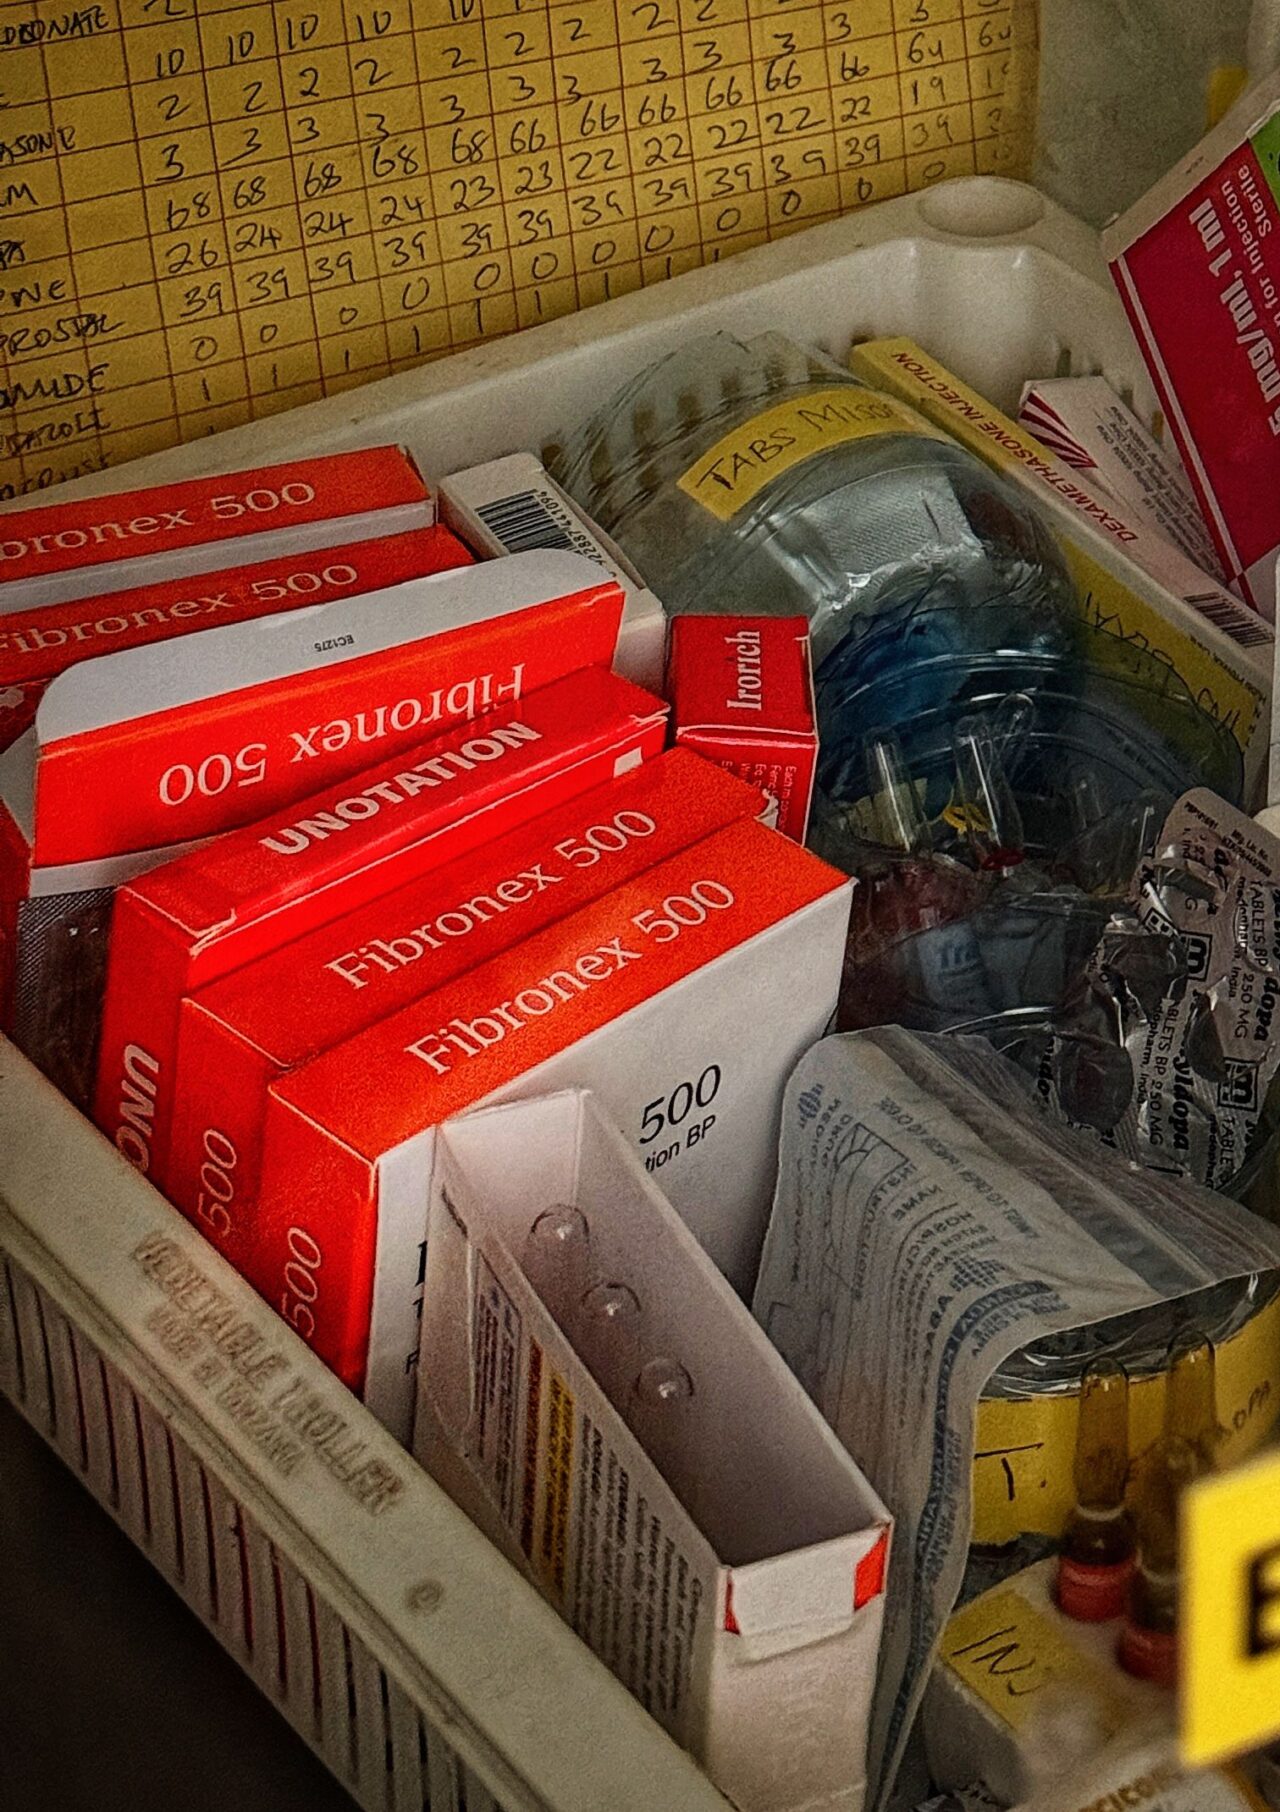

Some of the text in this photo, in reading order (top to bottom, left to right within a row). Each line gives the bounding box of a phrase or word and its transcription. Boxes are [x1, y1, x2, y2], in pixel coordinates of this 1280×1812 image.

[156, 10, 391, 79] 10 10 10 10
[157, 94, 192, 120] 2
[243, 81, 268, 112] 2
[299, 67, 319, 97] 2
[354, 59, 393, 86] 2
[441, 47, 476, 69] 2
[504, 31, 534, 56] 2
[562, 18, 591, 41] 2
[631, 3, 675, 31] 2
[155, 12, 851, 182] 3 3 3 3 3 3 3 3 3 3 3
[234, 176, 267, 210] 68
[304, 161, 342, 198] 68
[372, 144, 418, 178] 68
[452, 128, 492, 164] 68
[510, 118, 546, 154] 66
[580, 100, 621, 137] 66
[638, 93, 676, 127] 66
[705, 75, 743, 110] 66
[765, 57, 803, 92] 66
[166, 76, 946, 274] 26 24 24 24 23 23 22 22 22 22 22 19
[180, 282, 224, 318] 39
[246, 268, 290, 302] 39
[310, 250, 357, 284] 39
[383, 230, 427, 268] 39
[461, 222, 493, 259] 39
[516, 209, 554, 246] 39
[572, 190, 624, 226] 39
[643, 177, 690, 208] 39
[704, 164, 753, 199] 39
[770, 149, 827, 185] 39
[845, 134, 880, 167] 39
[1188, 197, 1226, 252] ml
[1238, 163, 1272, 239] Sterile
[259, 323, 279, 343] 0
[339, 306, 358, 325] 0
[402, 276, 430, 310] 0
[473, 262, 501, 290] 0
[531, 252, 559, 280] 0
[591, 240, 616, 265] 0
[643, 225, 675, 253] 0
[716, 206, 742, 232] 0
[780, 189, 802, 216] 0
[1208, 247, 1233, 277] 1
[1220, 180, 1265, 275] Injection
[891, 351, 985, 421] INJECTION
[209, 482, 316, 520] 500
[695, 425, 797, 491] TABS
[978, 420, 1139, 543] DEXAMETHASONE
[249, 565, 358, 600] 500
[312, 632, 355, 654] EC1275
[727, 628, 763, 712] Irorich
[159, 661, 526, 806] Fibronex 500
[259, 721, 544, 856] UNOTATION
[323, 808, 658, 991] Fibronex 500
[402, 878, 736, 1076] Fibronex 500
[1234, 880, 1271, 1040] TABLETS BP 250 MG
[638, 1063, 723, 1146] 500
[685, 1114, 717, 1150] BP
[1149, 1056, 1170, 1146] BP 250 MG
[198, 1128, 238, 1238] 500
[282, 1227, 323, 1338] 500
